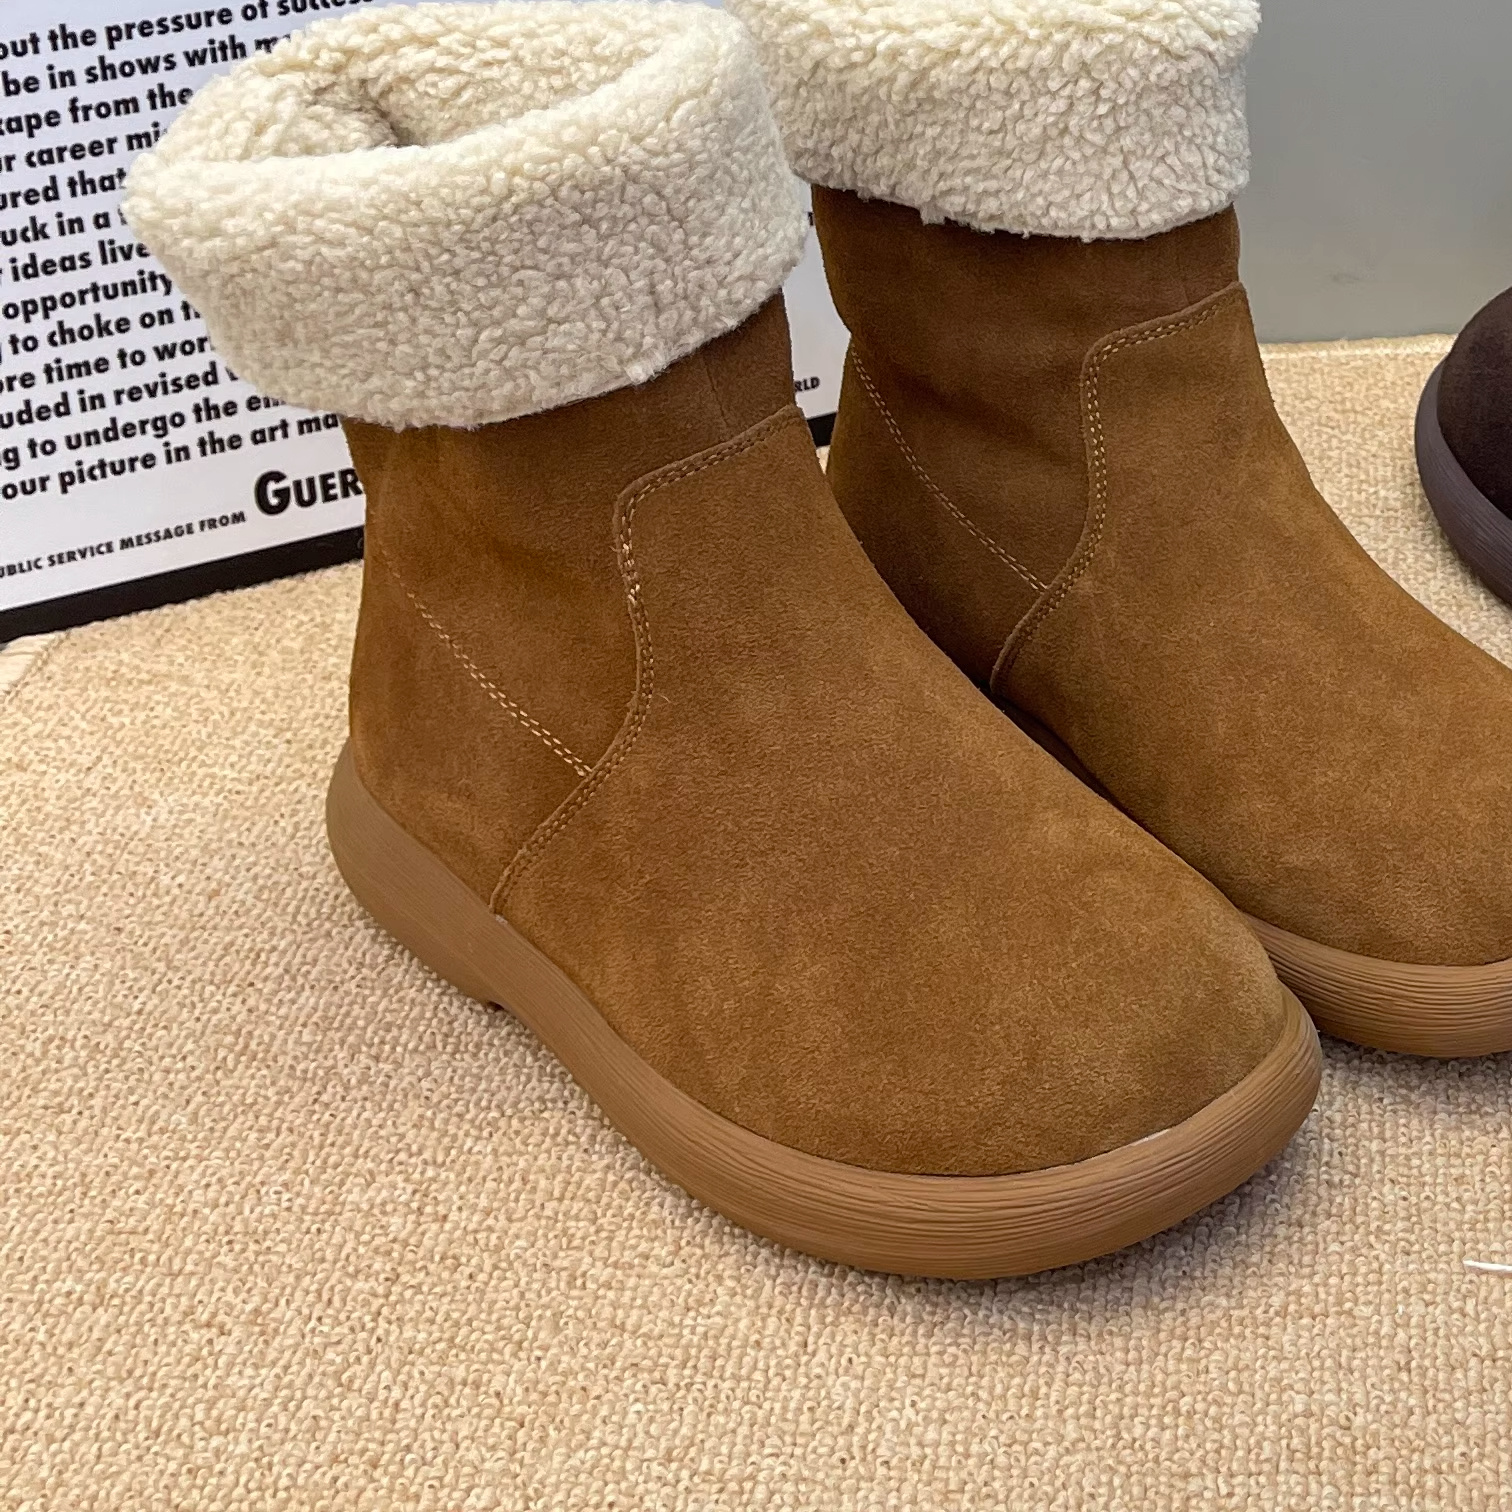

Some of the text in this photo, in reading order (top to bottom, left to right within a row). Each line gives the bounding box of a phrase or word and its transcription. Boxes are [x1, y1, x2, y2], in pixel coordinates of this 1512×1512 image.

[48, 23, 97, 51] the
[105, 7, 233, 50] pressure
[2, 70, 40, 97] be
[46, 64, 77, 89] in
[84, 55, 177, 84] shows
[183, 34, 247, 67] with
[69, 96, 140, 123] from
[147, 82, 193, 110] the
[25, 137, 118, 168] career
[56, 212, 85, 236] in
[92, 211, 111, 229] a
[9, 252, 92, 282] ideas
[8, 333, 39, 356] to
[47, 313, 131, 348] choke
[139, 307, 174, 329] on
[43, 356, 110, 385] time
[117, 348, 146, 369] to
[77, 389, 106, 413] in
[114, 360, 219, 405] revised
[28, 438, 57, 459] to
[64, 417, 186, 450] undergo
[192, 397, 238, 423] the
[58, 452, 157, 494] picture
[162, 442, 191, 465] in
[197, 431, 243, 458] the
[250, 419, 289, 445] art
[47, 542, 114, 567] SERVICE
[119, 523, 194, 550] MESSAGE
[199, 511, 246, 532] FROM
